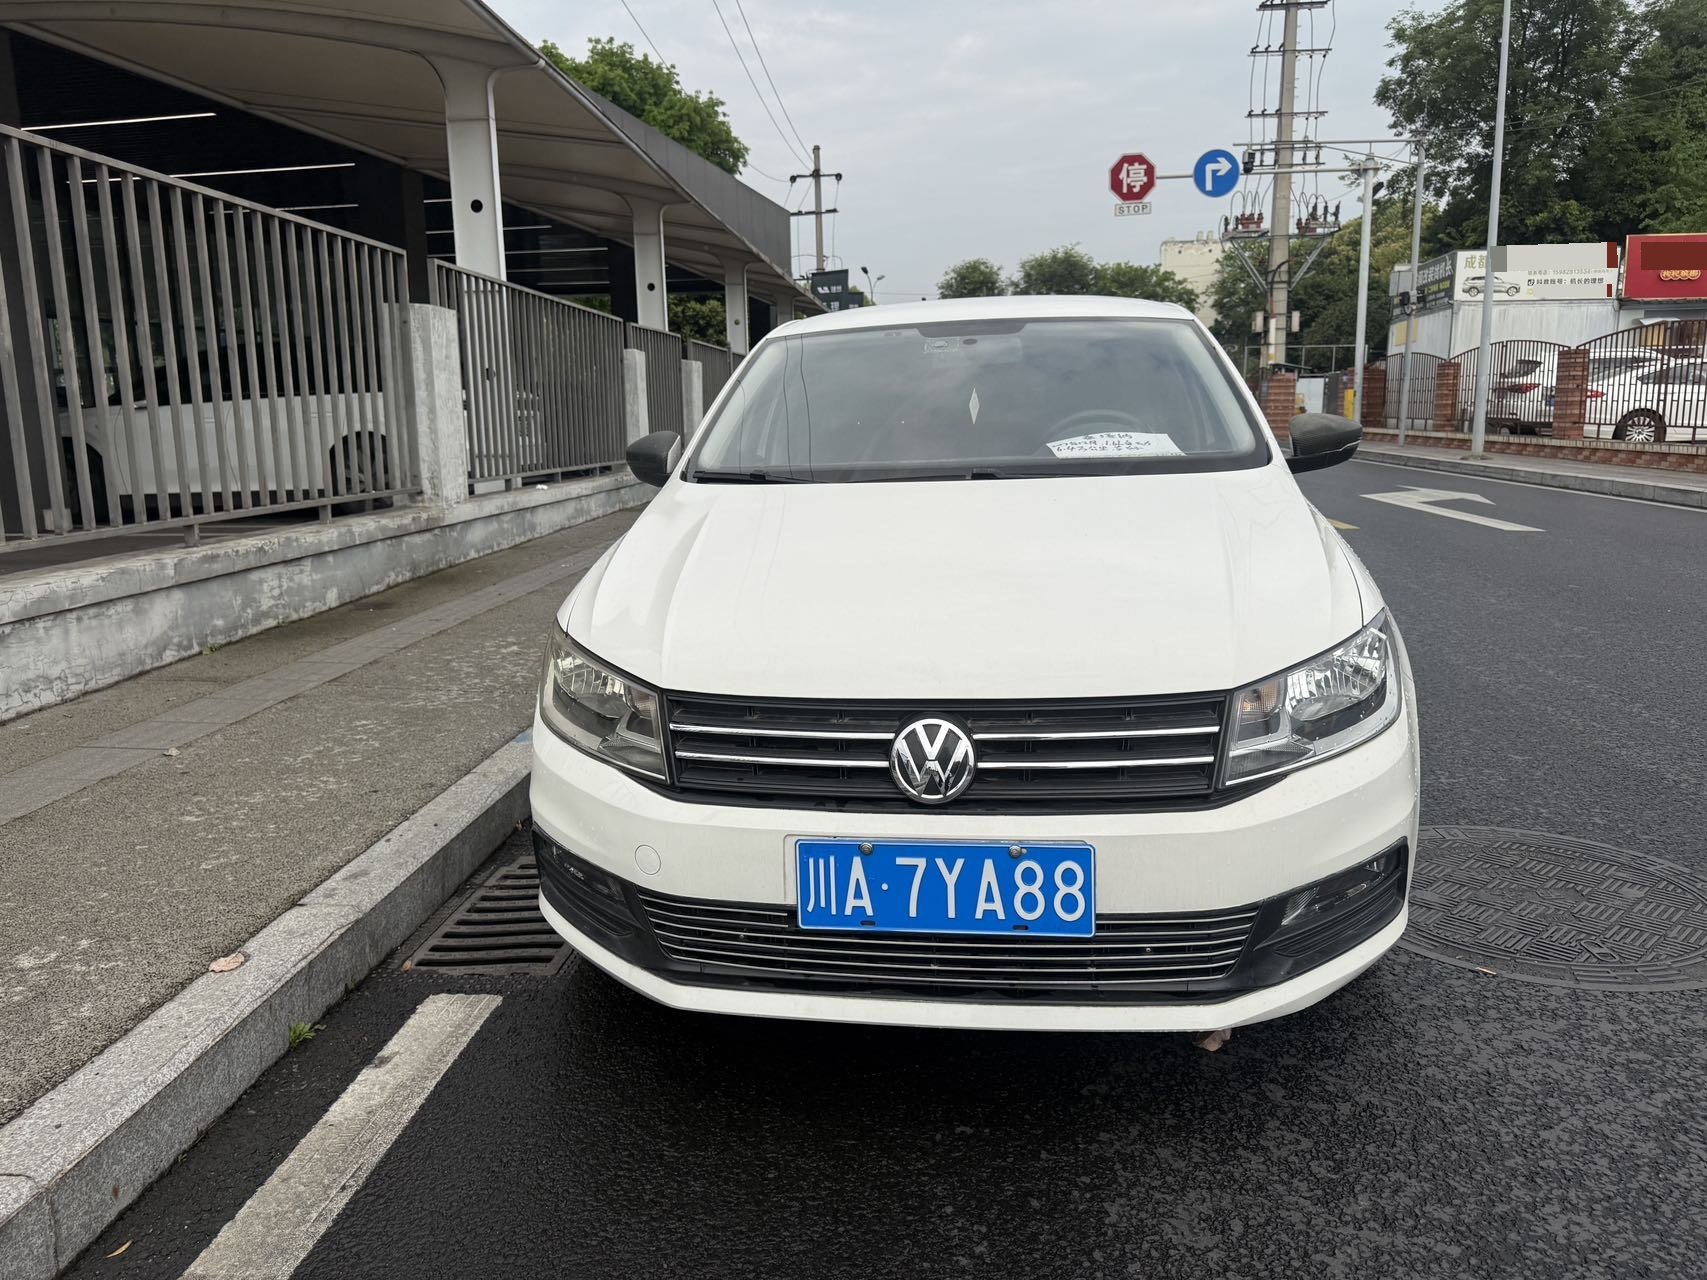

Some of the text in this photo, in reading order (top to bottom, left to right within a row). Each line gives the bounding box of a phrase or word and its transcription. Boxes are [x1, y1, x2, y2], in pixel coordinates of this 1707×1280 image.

[1119, 162, 1147, 193] 停
[1118, 204, 1148, 215] STOP
[806, 855, 1086, 922] 川A·7YA88
